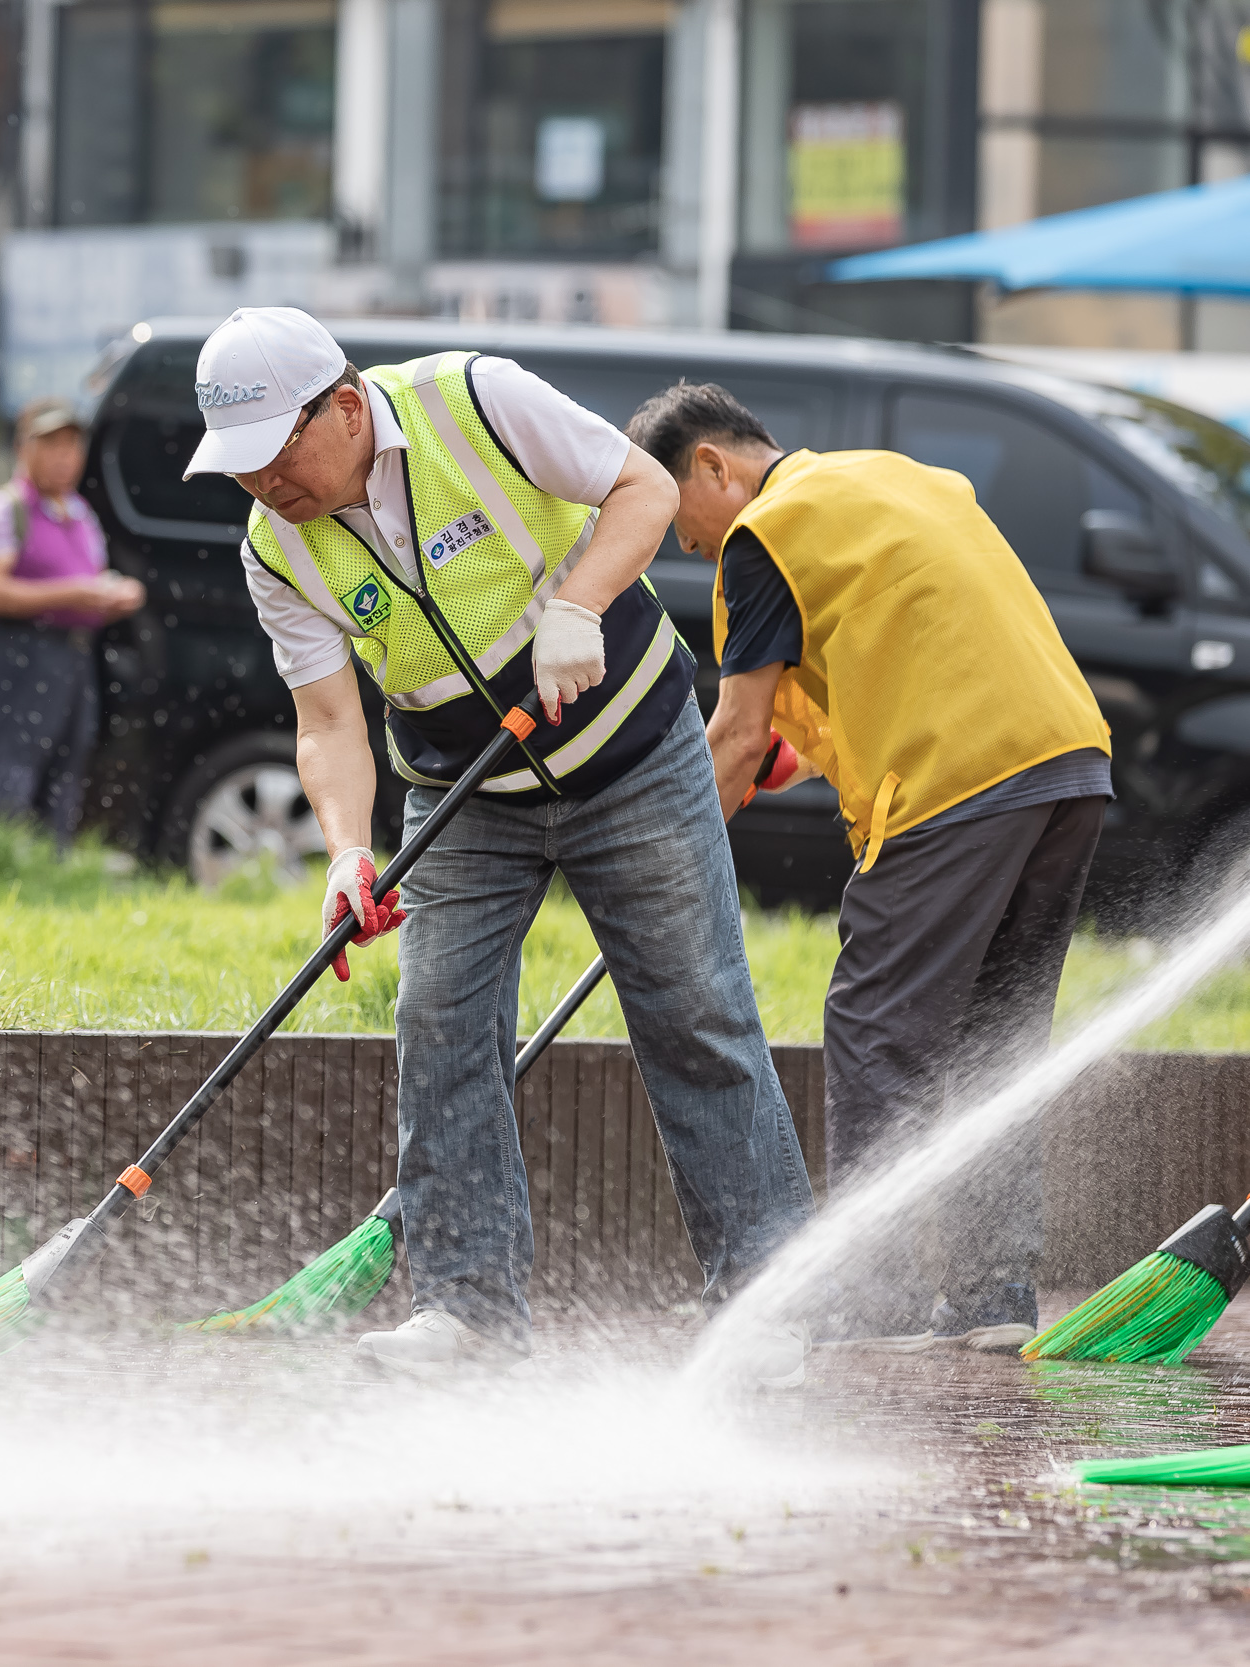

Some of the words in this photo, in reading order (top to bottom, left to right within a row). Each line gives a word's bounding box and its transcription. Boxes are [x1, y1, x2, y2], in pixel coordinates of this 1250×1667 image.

[291, 374, 322, 401] PRO
[321, 362, 337, 377] V1
[447, 523, 490, 553] 광진구청장
[361, 602, 391, 626] 광진구
